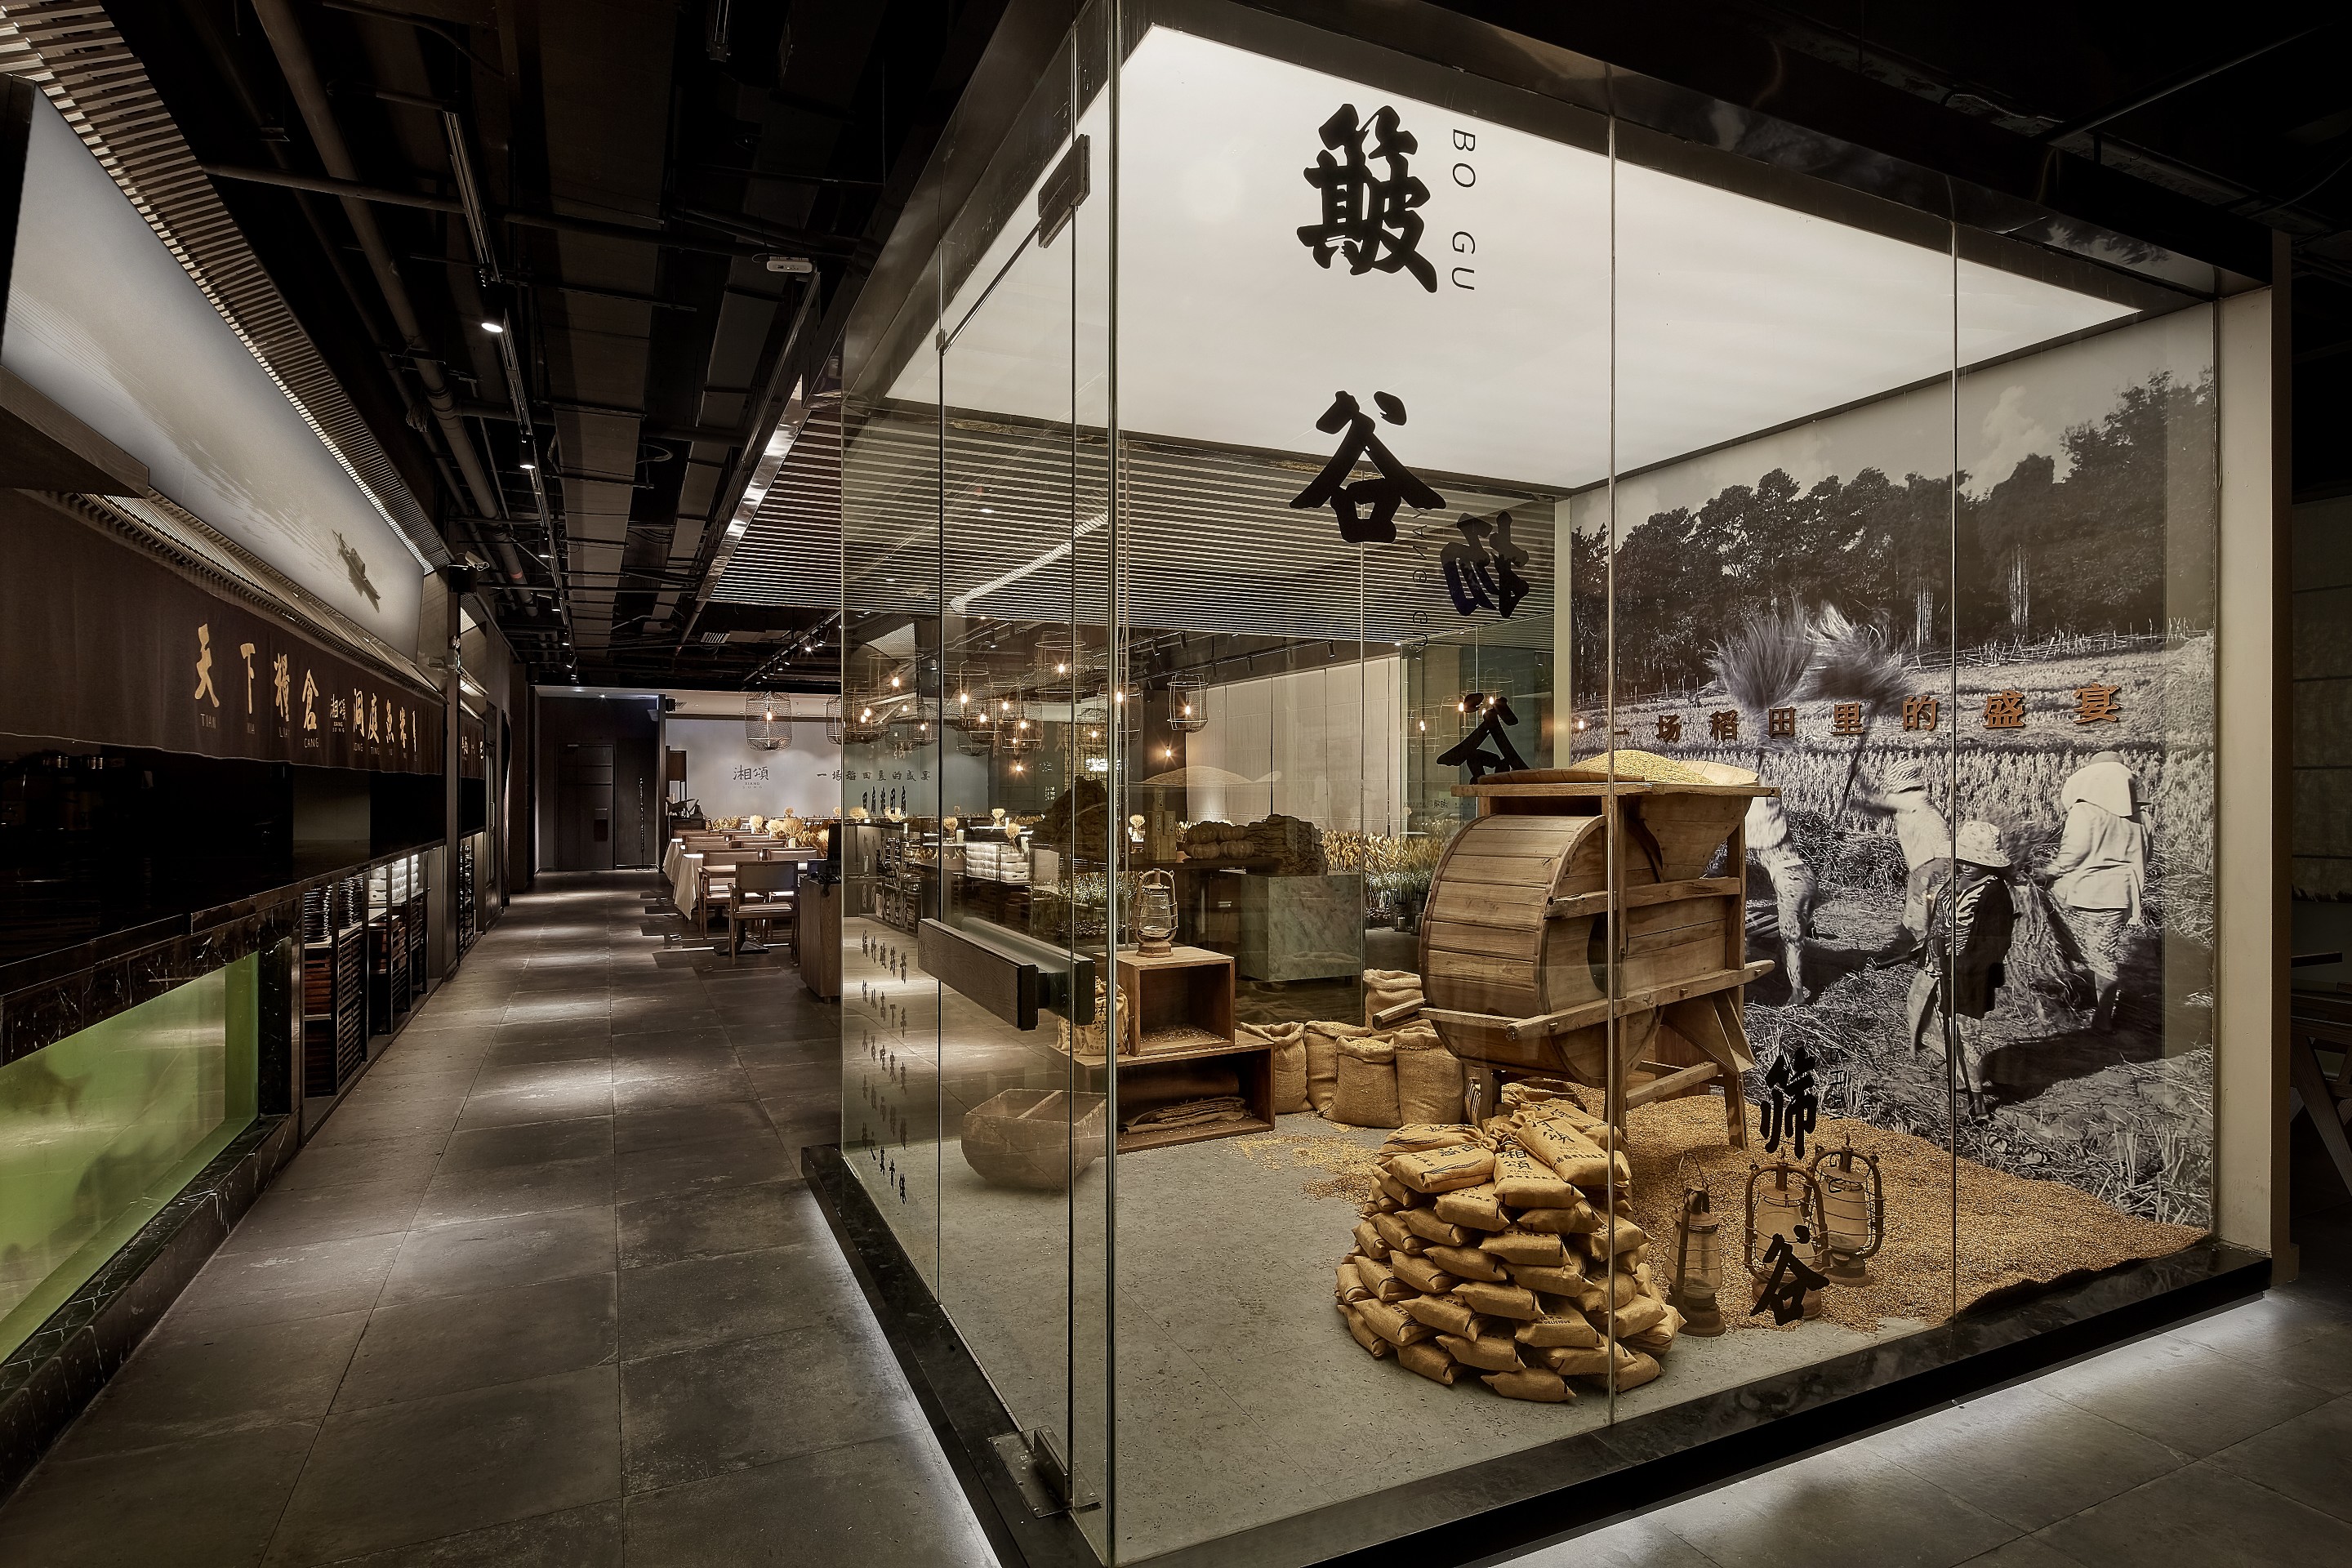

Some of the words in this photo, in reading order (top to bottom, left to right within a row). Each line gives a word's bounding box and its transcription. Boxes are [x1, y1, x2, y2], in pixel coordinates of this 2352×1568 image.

[1450, 127, 1477, 189] BO
[1450, 230, 1477, 292] GU
[304, 737, 319, 749] CANG
[733, 764, 769, 781] 湘頌
